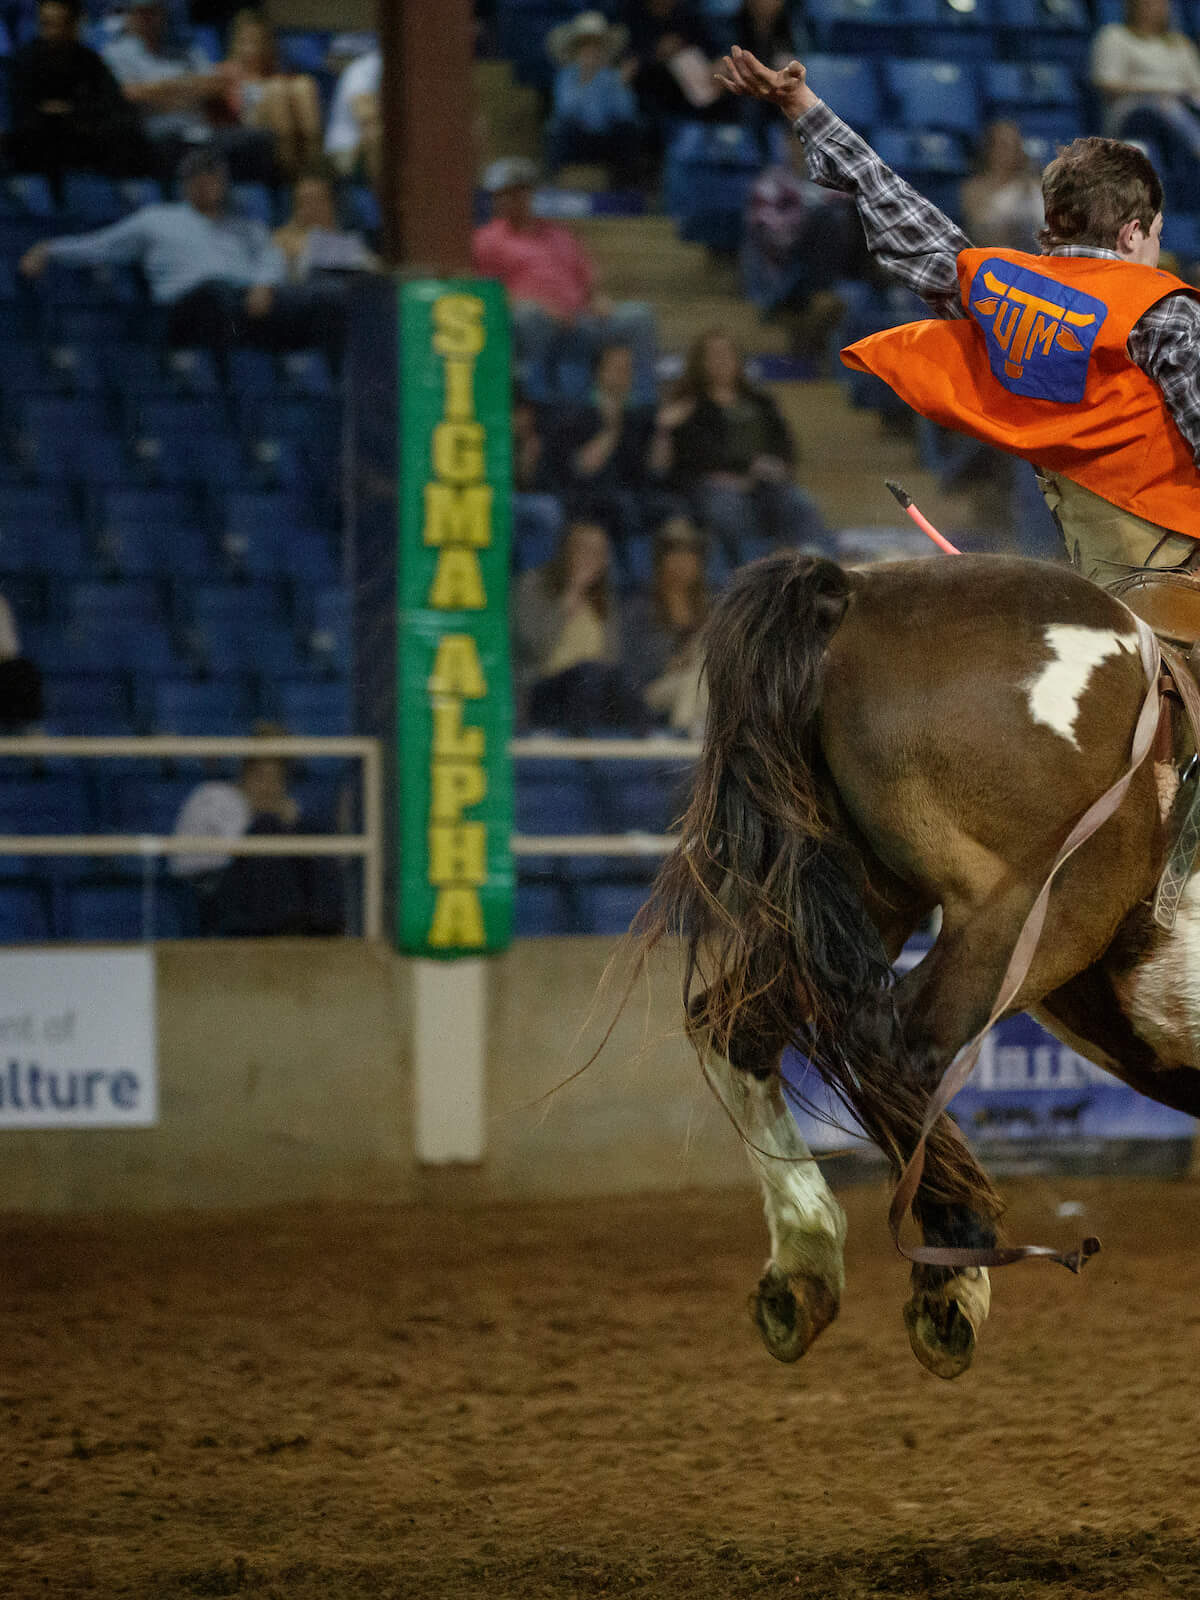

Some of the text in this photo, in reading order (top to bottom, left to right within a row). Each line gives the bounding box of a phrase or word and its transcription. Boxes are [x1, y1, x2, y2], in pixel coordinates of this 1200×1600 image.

[990, 282, 1068, 366] UTM
[423, 293, 493, 947] SIGMA ALPHA
[0, 1059, 140, 1110] lture
